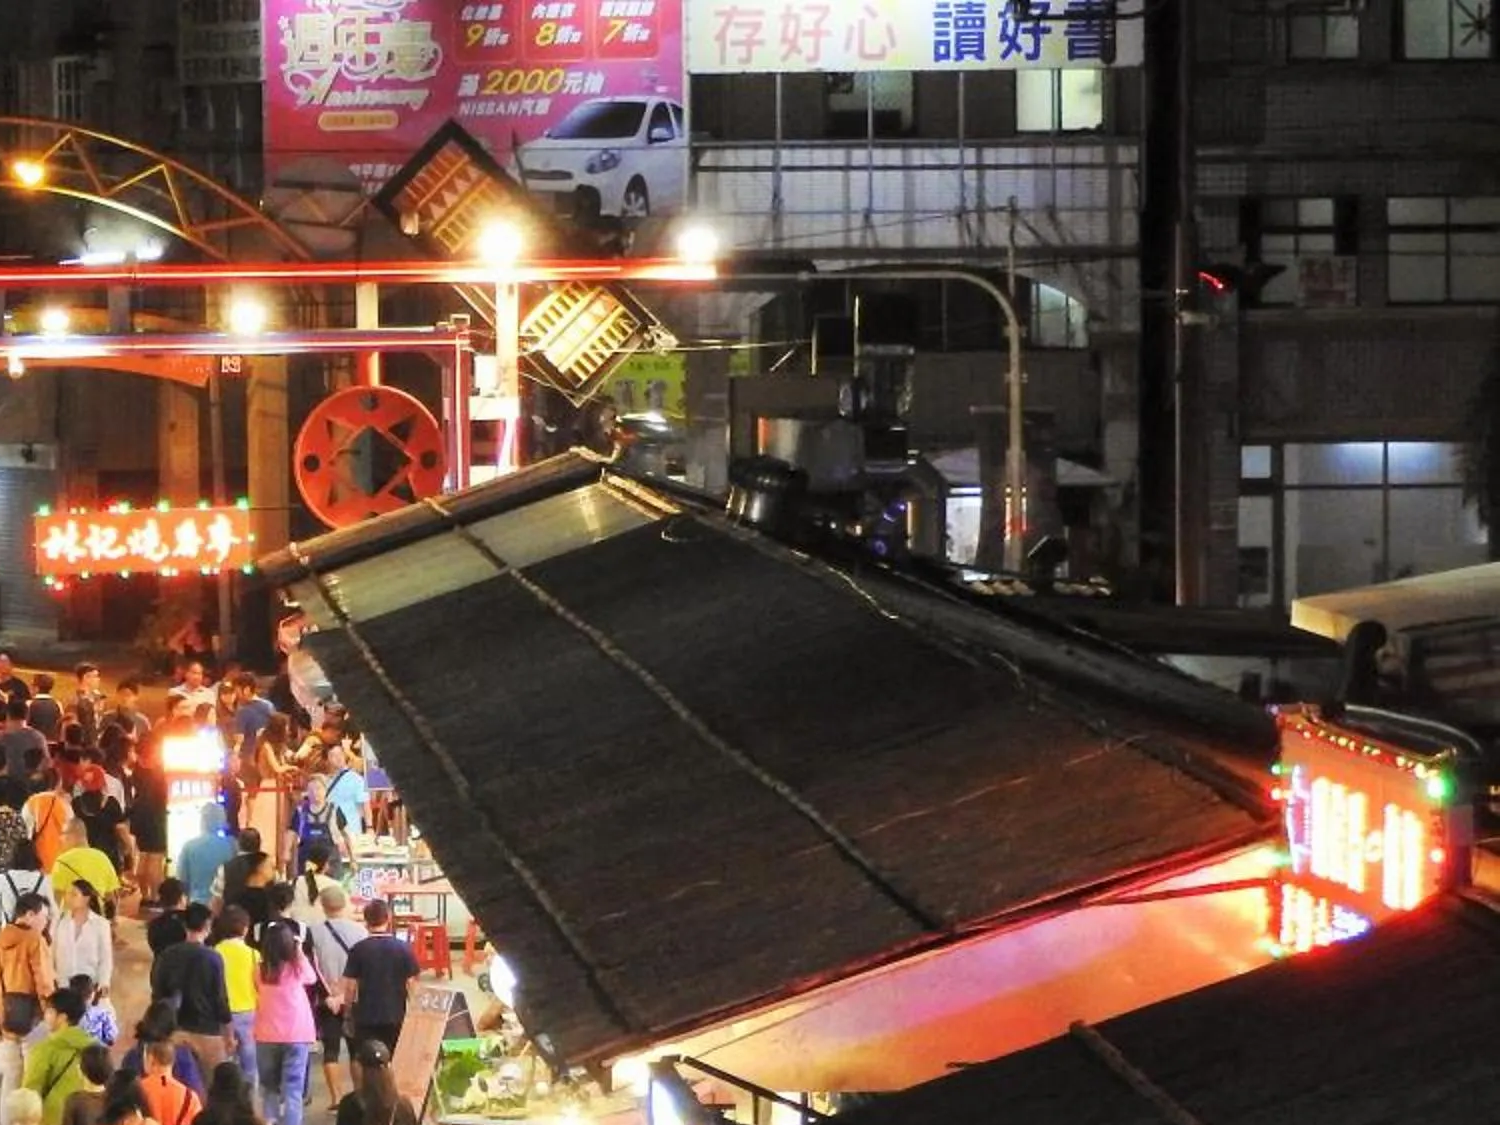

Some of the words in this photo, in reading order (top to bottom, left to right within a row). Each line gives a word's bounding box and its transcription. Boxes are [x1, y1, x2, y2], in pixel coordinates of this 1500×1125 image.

[714, 5, 896, 66] 存好心
[933, 1, 1117, 64] 讀好書
